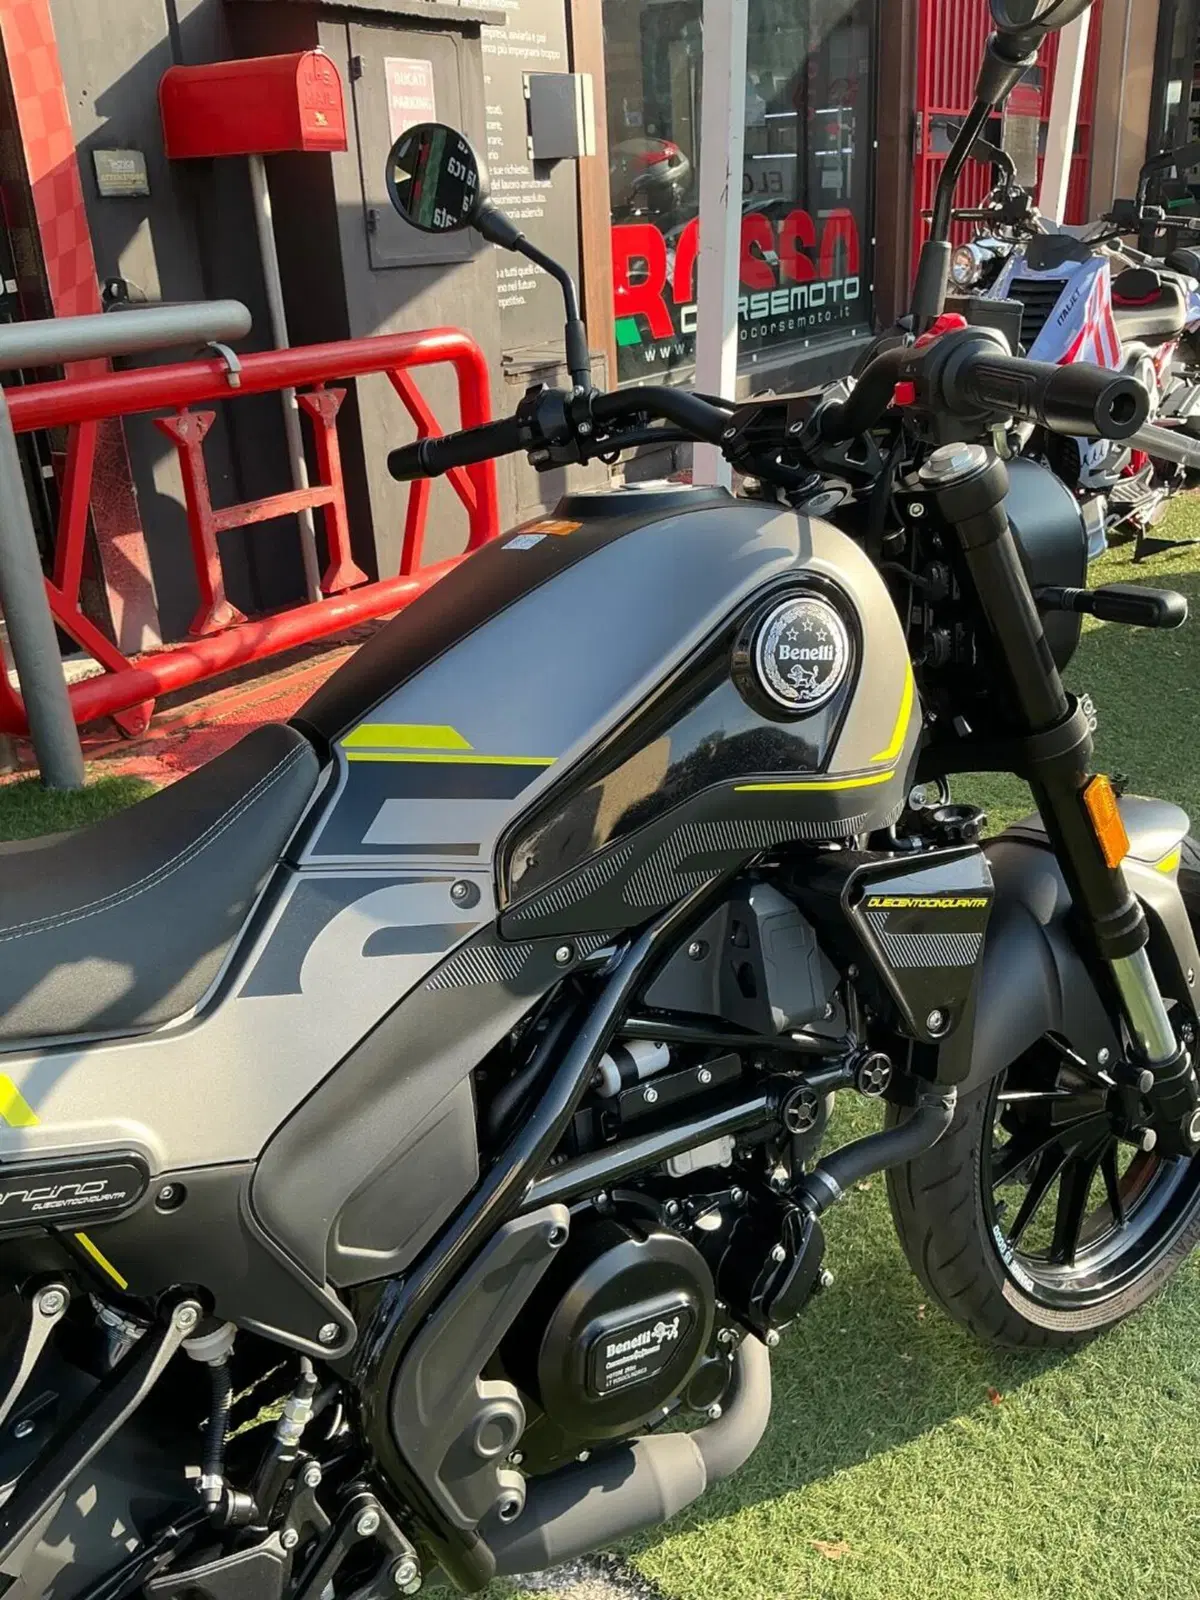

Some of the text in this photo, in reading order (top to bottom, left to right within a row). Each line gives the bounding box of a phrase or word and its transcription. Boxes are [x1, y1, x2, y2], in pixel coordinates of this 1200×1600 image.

[681, 276, 860, 334] CRSEMOTO
[1056, 287, 1081, 327] ITALJET
[778, 644, 834, 661] Benelli
[606, 1330, 651, 1358] Benelli
